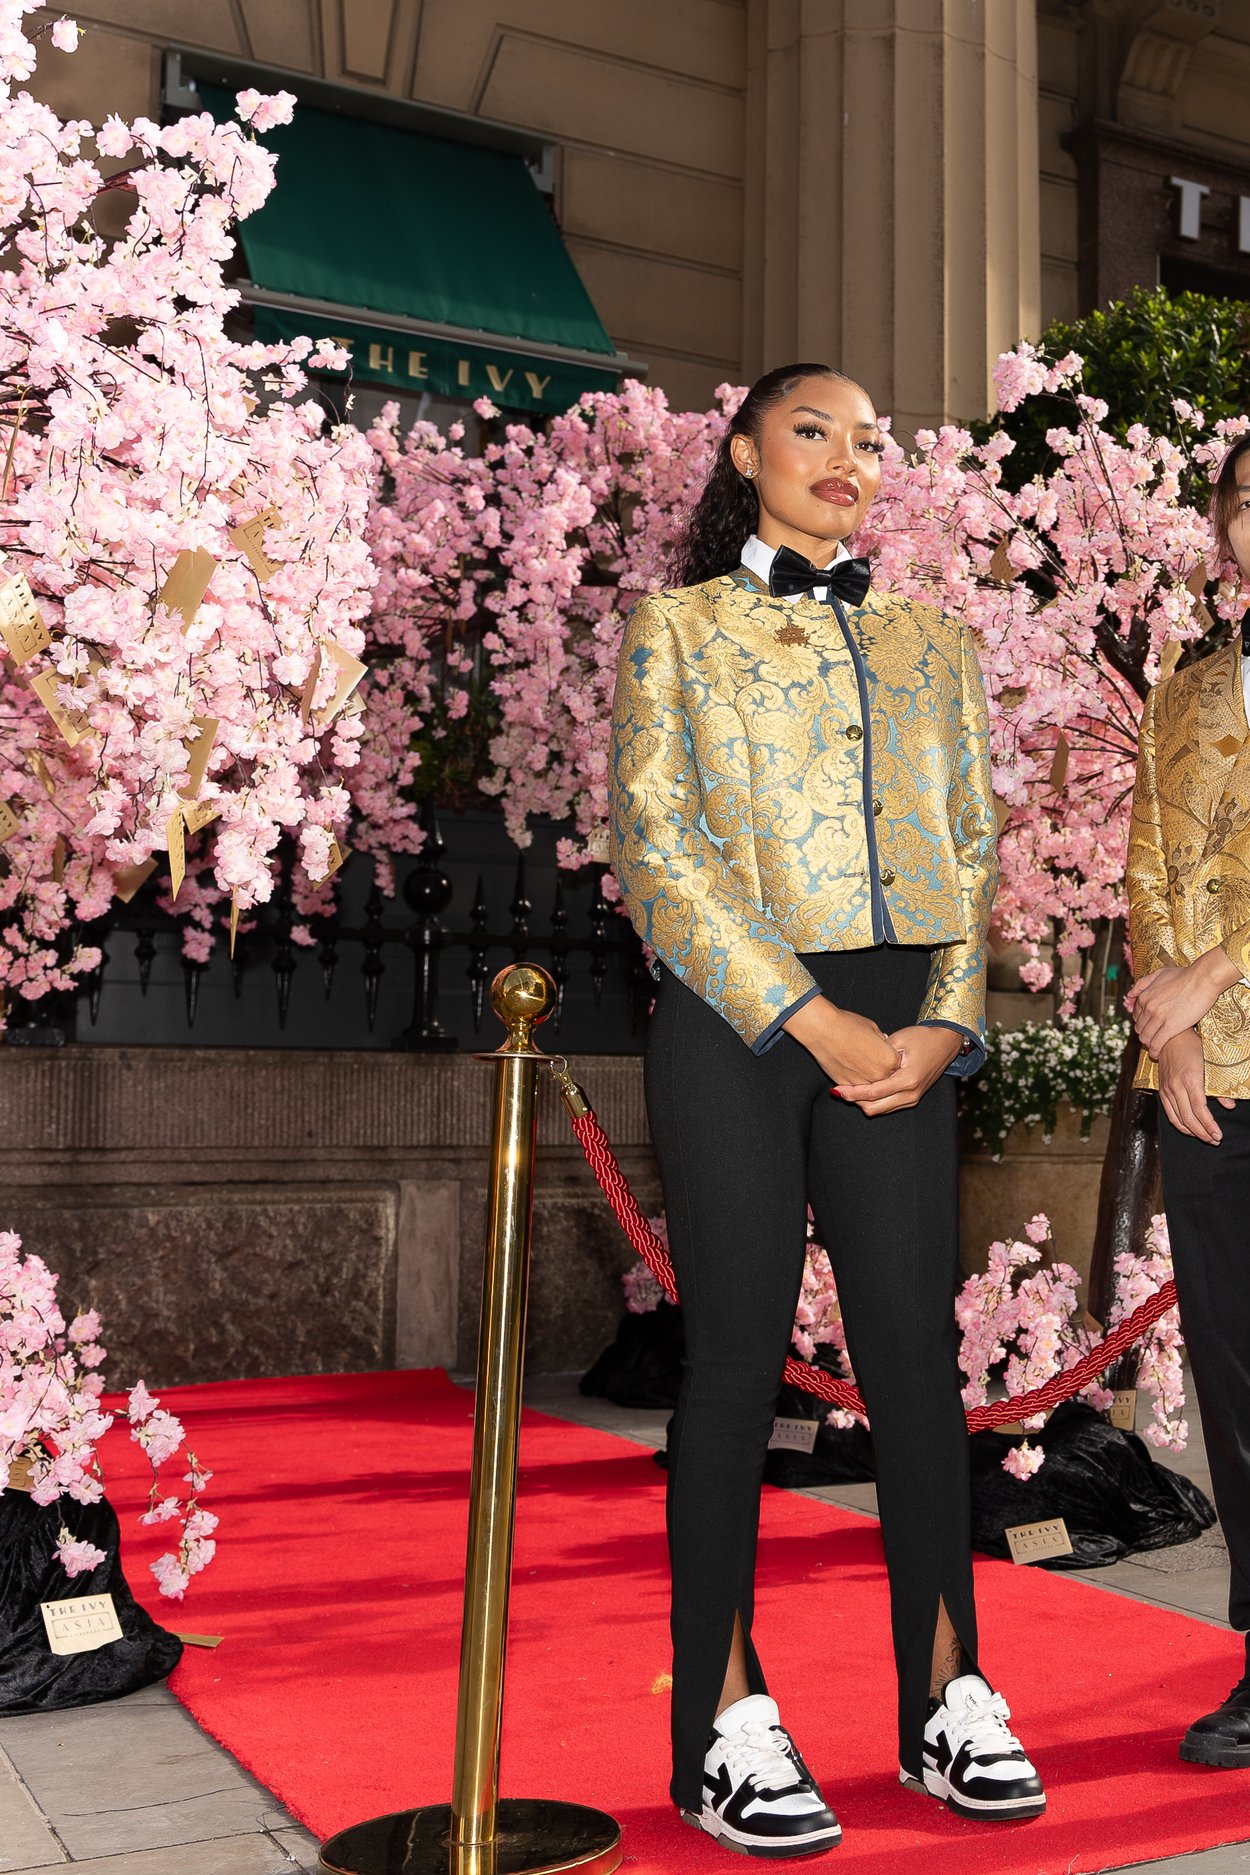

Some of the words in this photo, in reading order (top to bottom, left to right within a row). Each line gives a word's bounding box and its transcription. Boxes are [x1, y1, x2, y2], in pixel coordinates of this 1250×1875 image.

[458, 360, 551, 399] IVY
[1012, 1530, 1034, 1540] THE
[1038, 1525, 1060, 1534] IVY
[1022, 1536, 1058, 1549] ASIA
[49, 1605, 76, 1617] THE
[81, 1600, 106, 1612] IVY
[62, 1617, 105, 1632] ASIA
